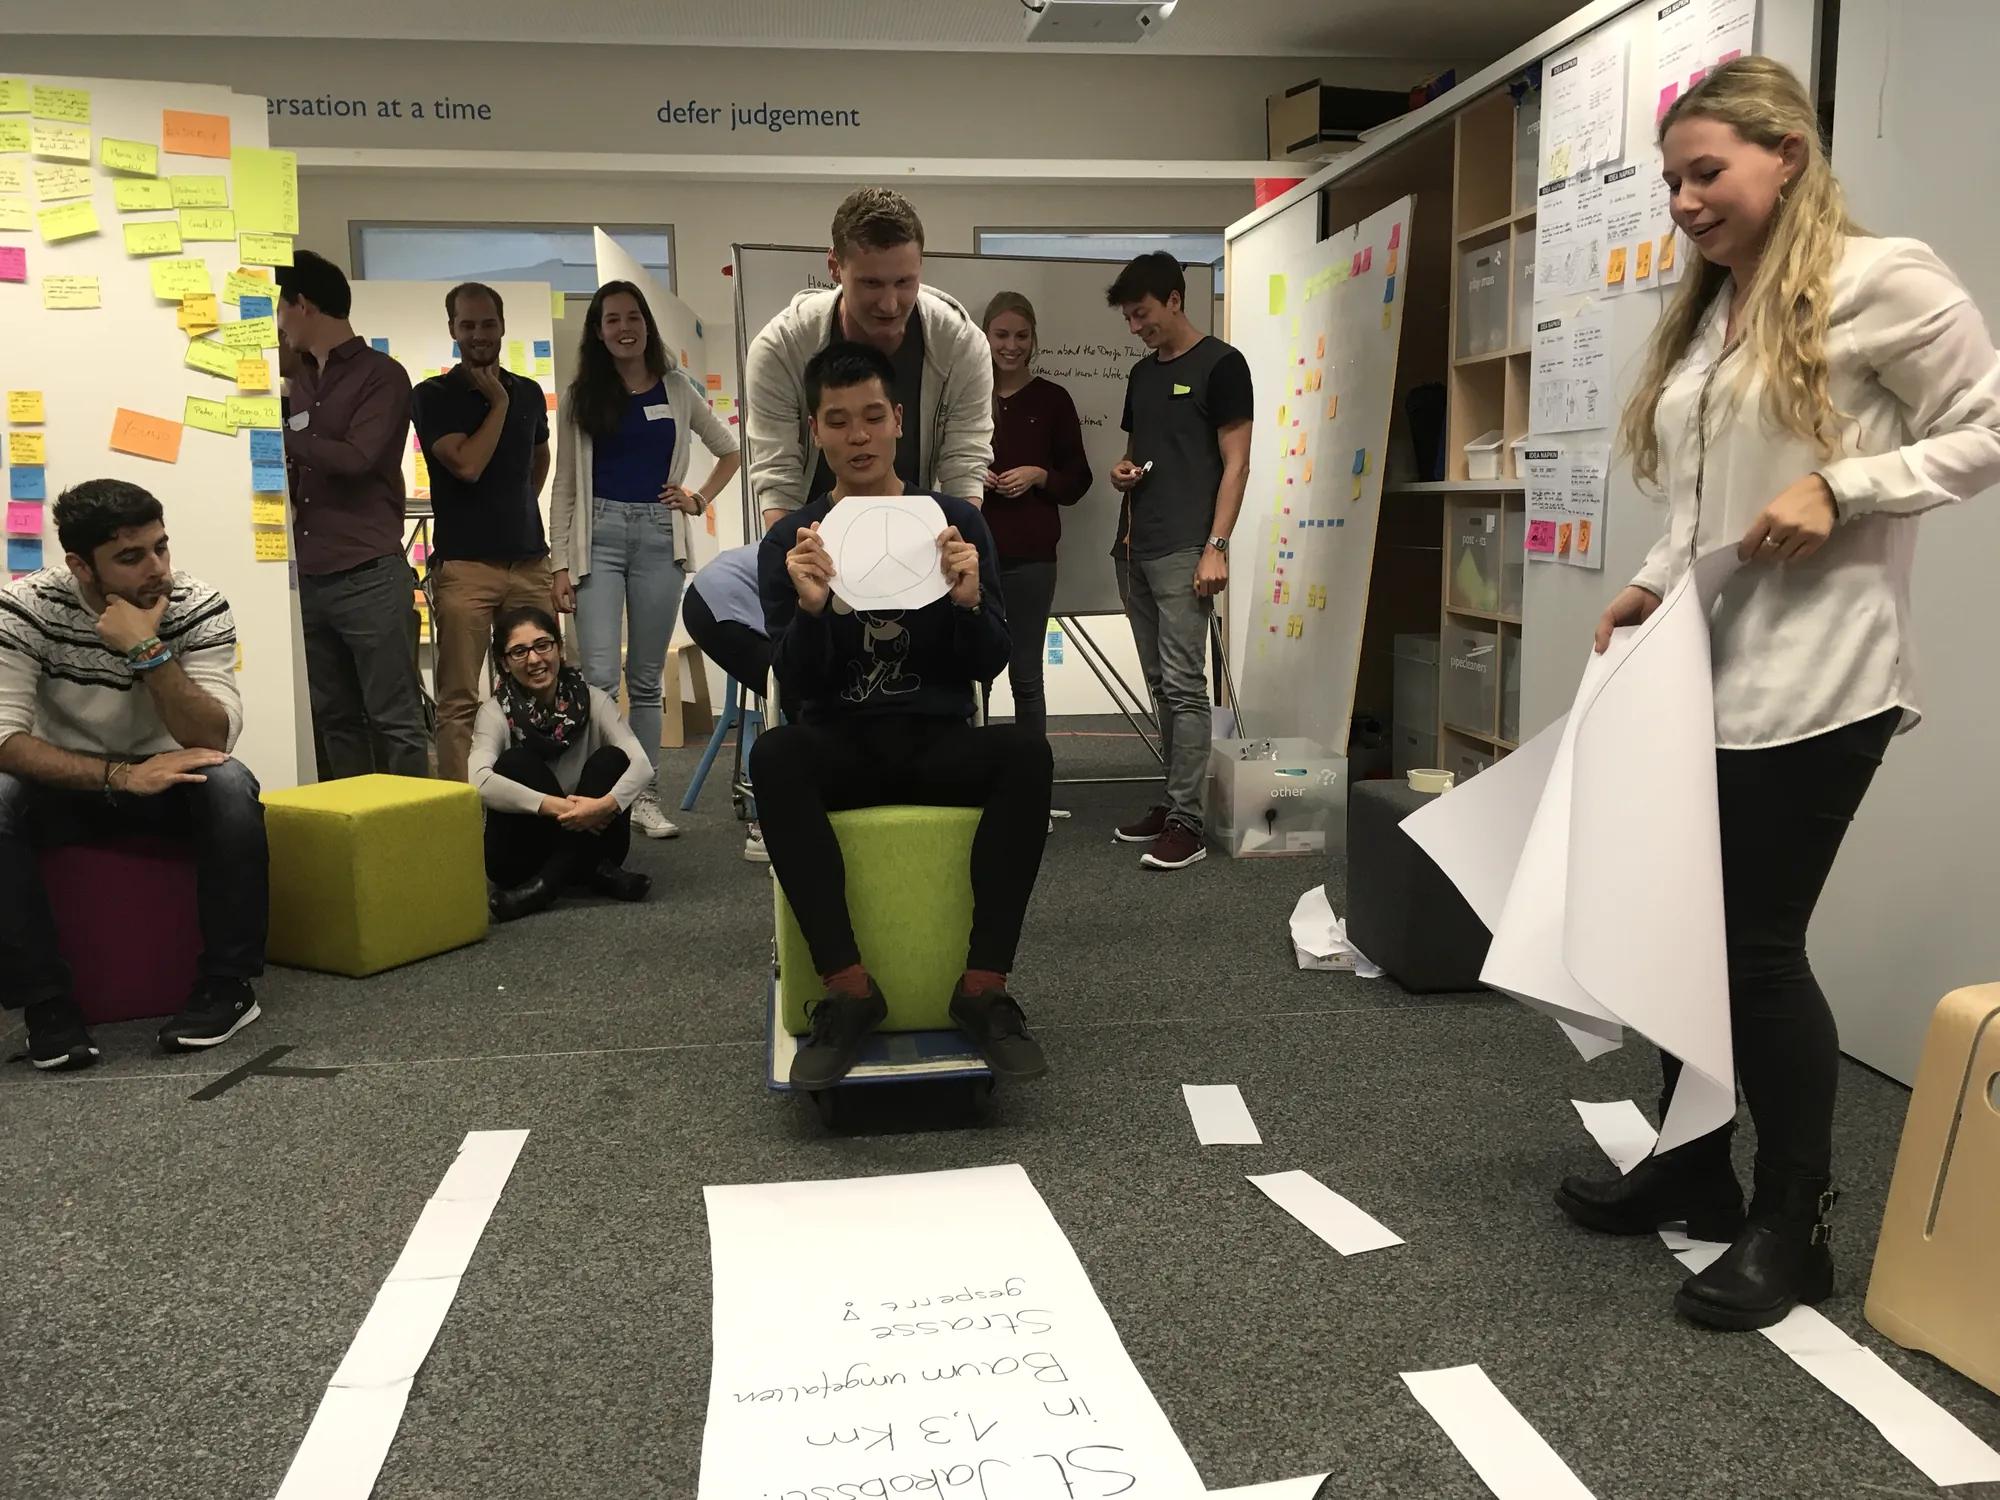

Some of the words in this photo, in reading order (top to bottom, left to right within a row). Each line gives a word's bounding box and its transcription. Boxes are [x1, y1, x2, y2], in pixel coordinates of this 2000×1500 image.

[1563, 58, 1578, 72] NAPKIN
[266, 94, 367, 117] ersation
[377, 99, 402, 118] at
[411, 101, 425, 118] a
[434, 97, 492, 121] time
[657, 100, 722, 124] defer
[731, 101, 861, 133] judgement
[1551, 180, 1565, 192] NAPKIN
[1619, 168, 1635, 179] NAPKIN
[281, 156, 294, 232] INTERVIEW
[1083, 344, 1096, 356] the
[1054, 367, 1073, 378] and
[1541, 451, 1558, 459] NAPKIN
[1450, 655, 1488, 673] pipecleaners
[1270, 784, 1306, 799] other
[880, 1277, 1026, 1312] gesperrt
[870, 1309, 1052, 1340] Strasse
[921, 1351, 1070, 1384] Baum
[732, 1362, 907, 1404] umgefallen
[1042, 1396, 1099, 1426] in
[918, 1410, 999, 1445] 1,3
[1021, 1445, 1137, 1500] St.
